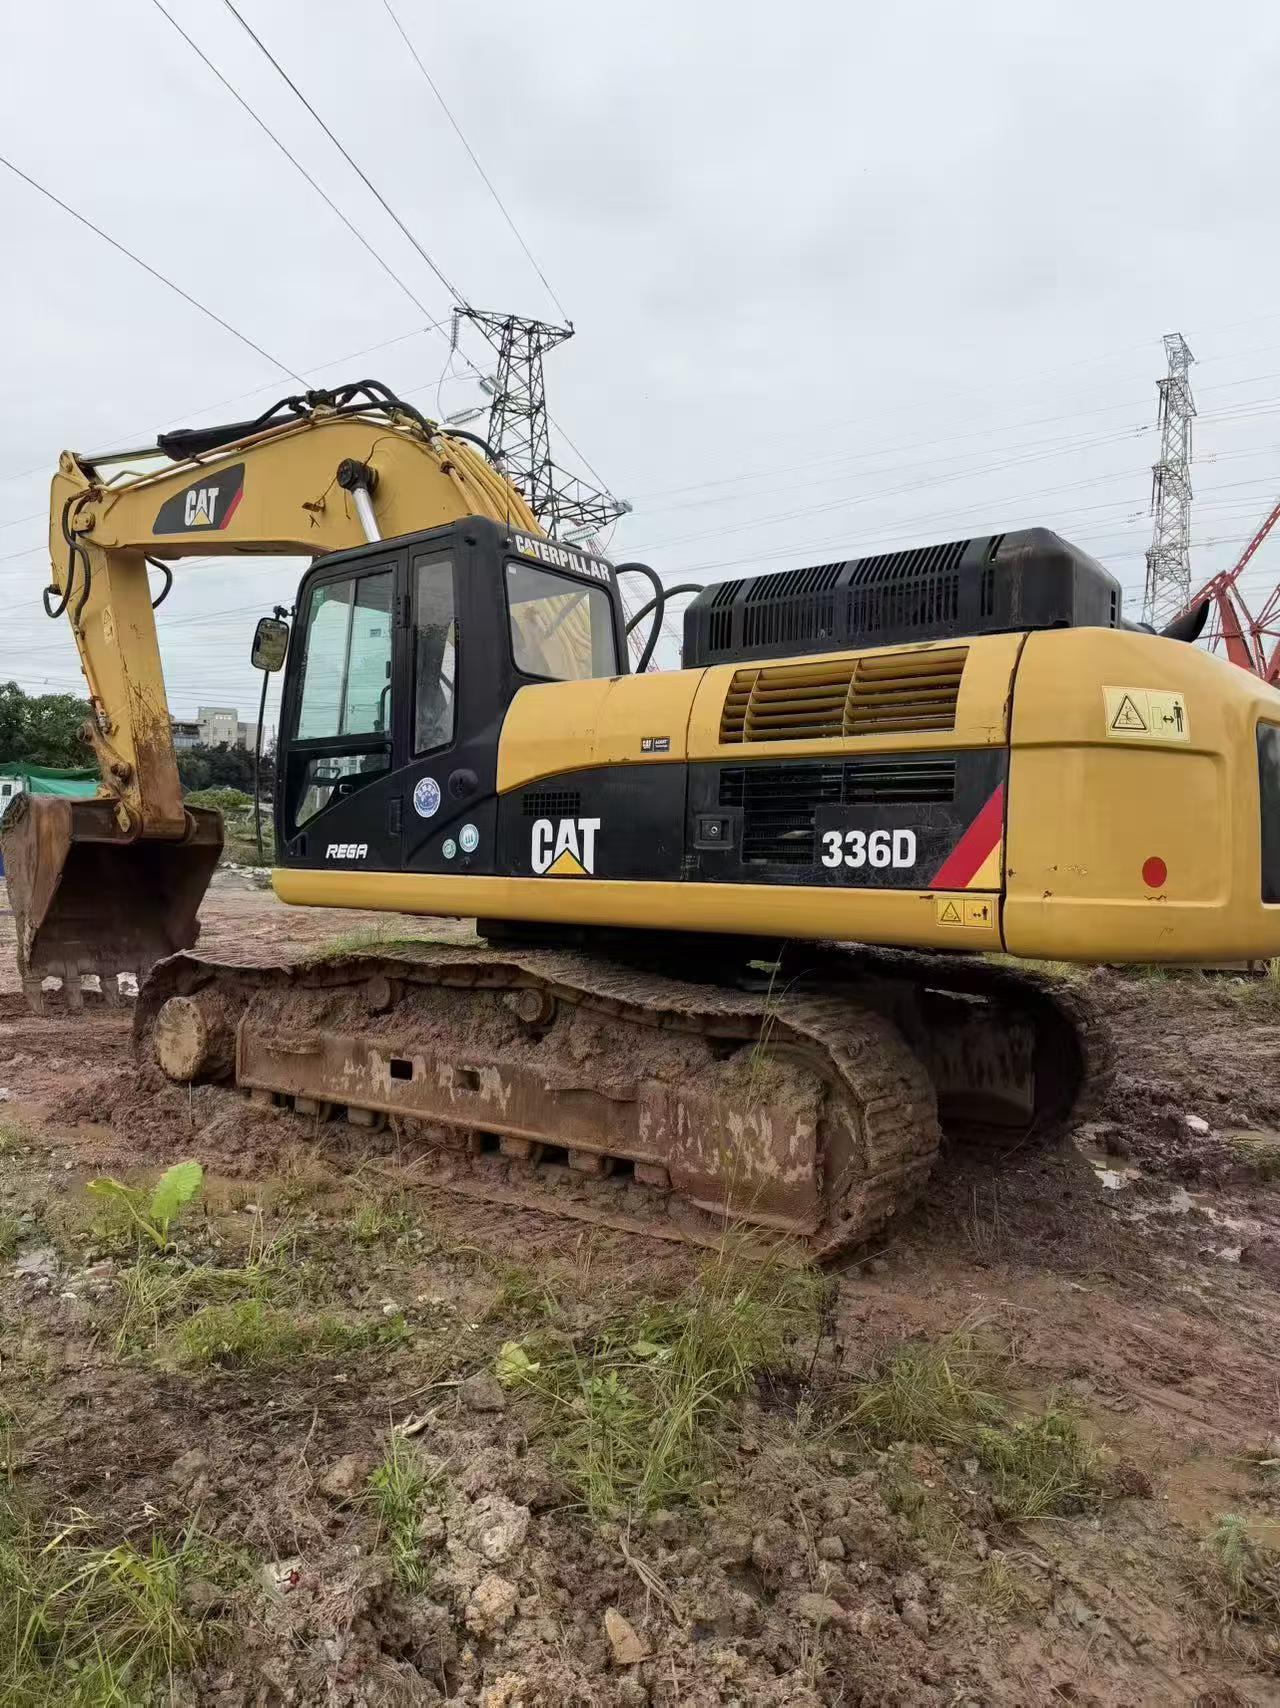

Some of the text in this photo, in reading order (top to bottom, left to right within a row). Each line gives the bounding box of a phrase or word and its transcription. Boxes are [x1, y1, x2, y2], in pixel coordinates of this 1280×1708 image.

[184, 487, 220, 526] CAT
[515, 534, 611, 583] CATERPILLAR
[325, 843, 368, 859] REGA
[531, 817, 601, 875] CAT
[821, 829, 917, 868] 336D
